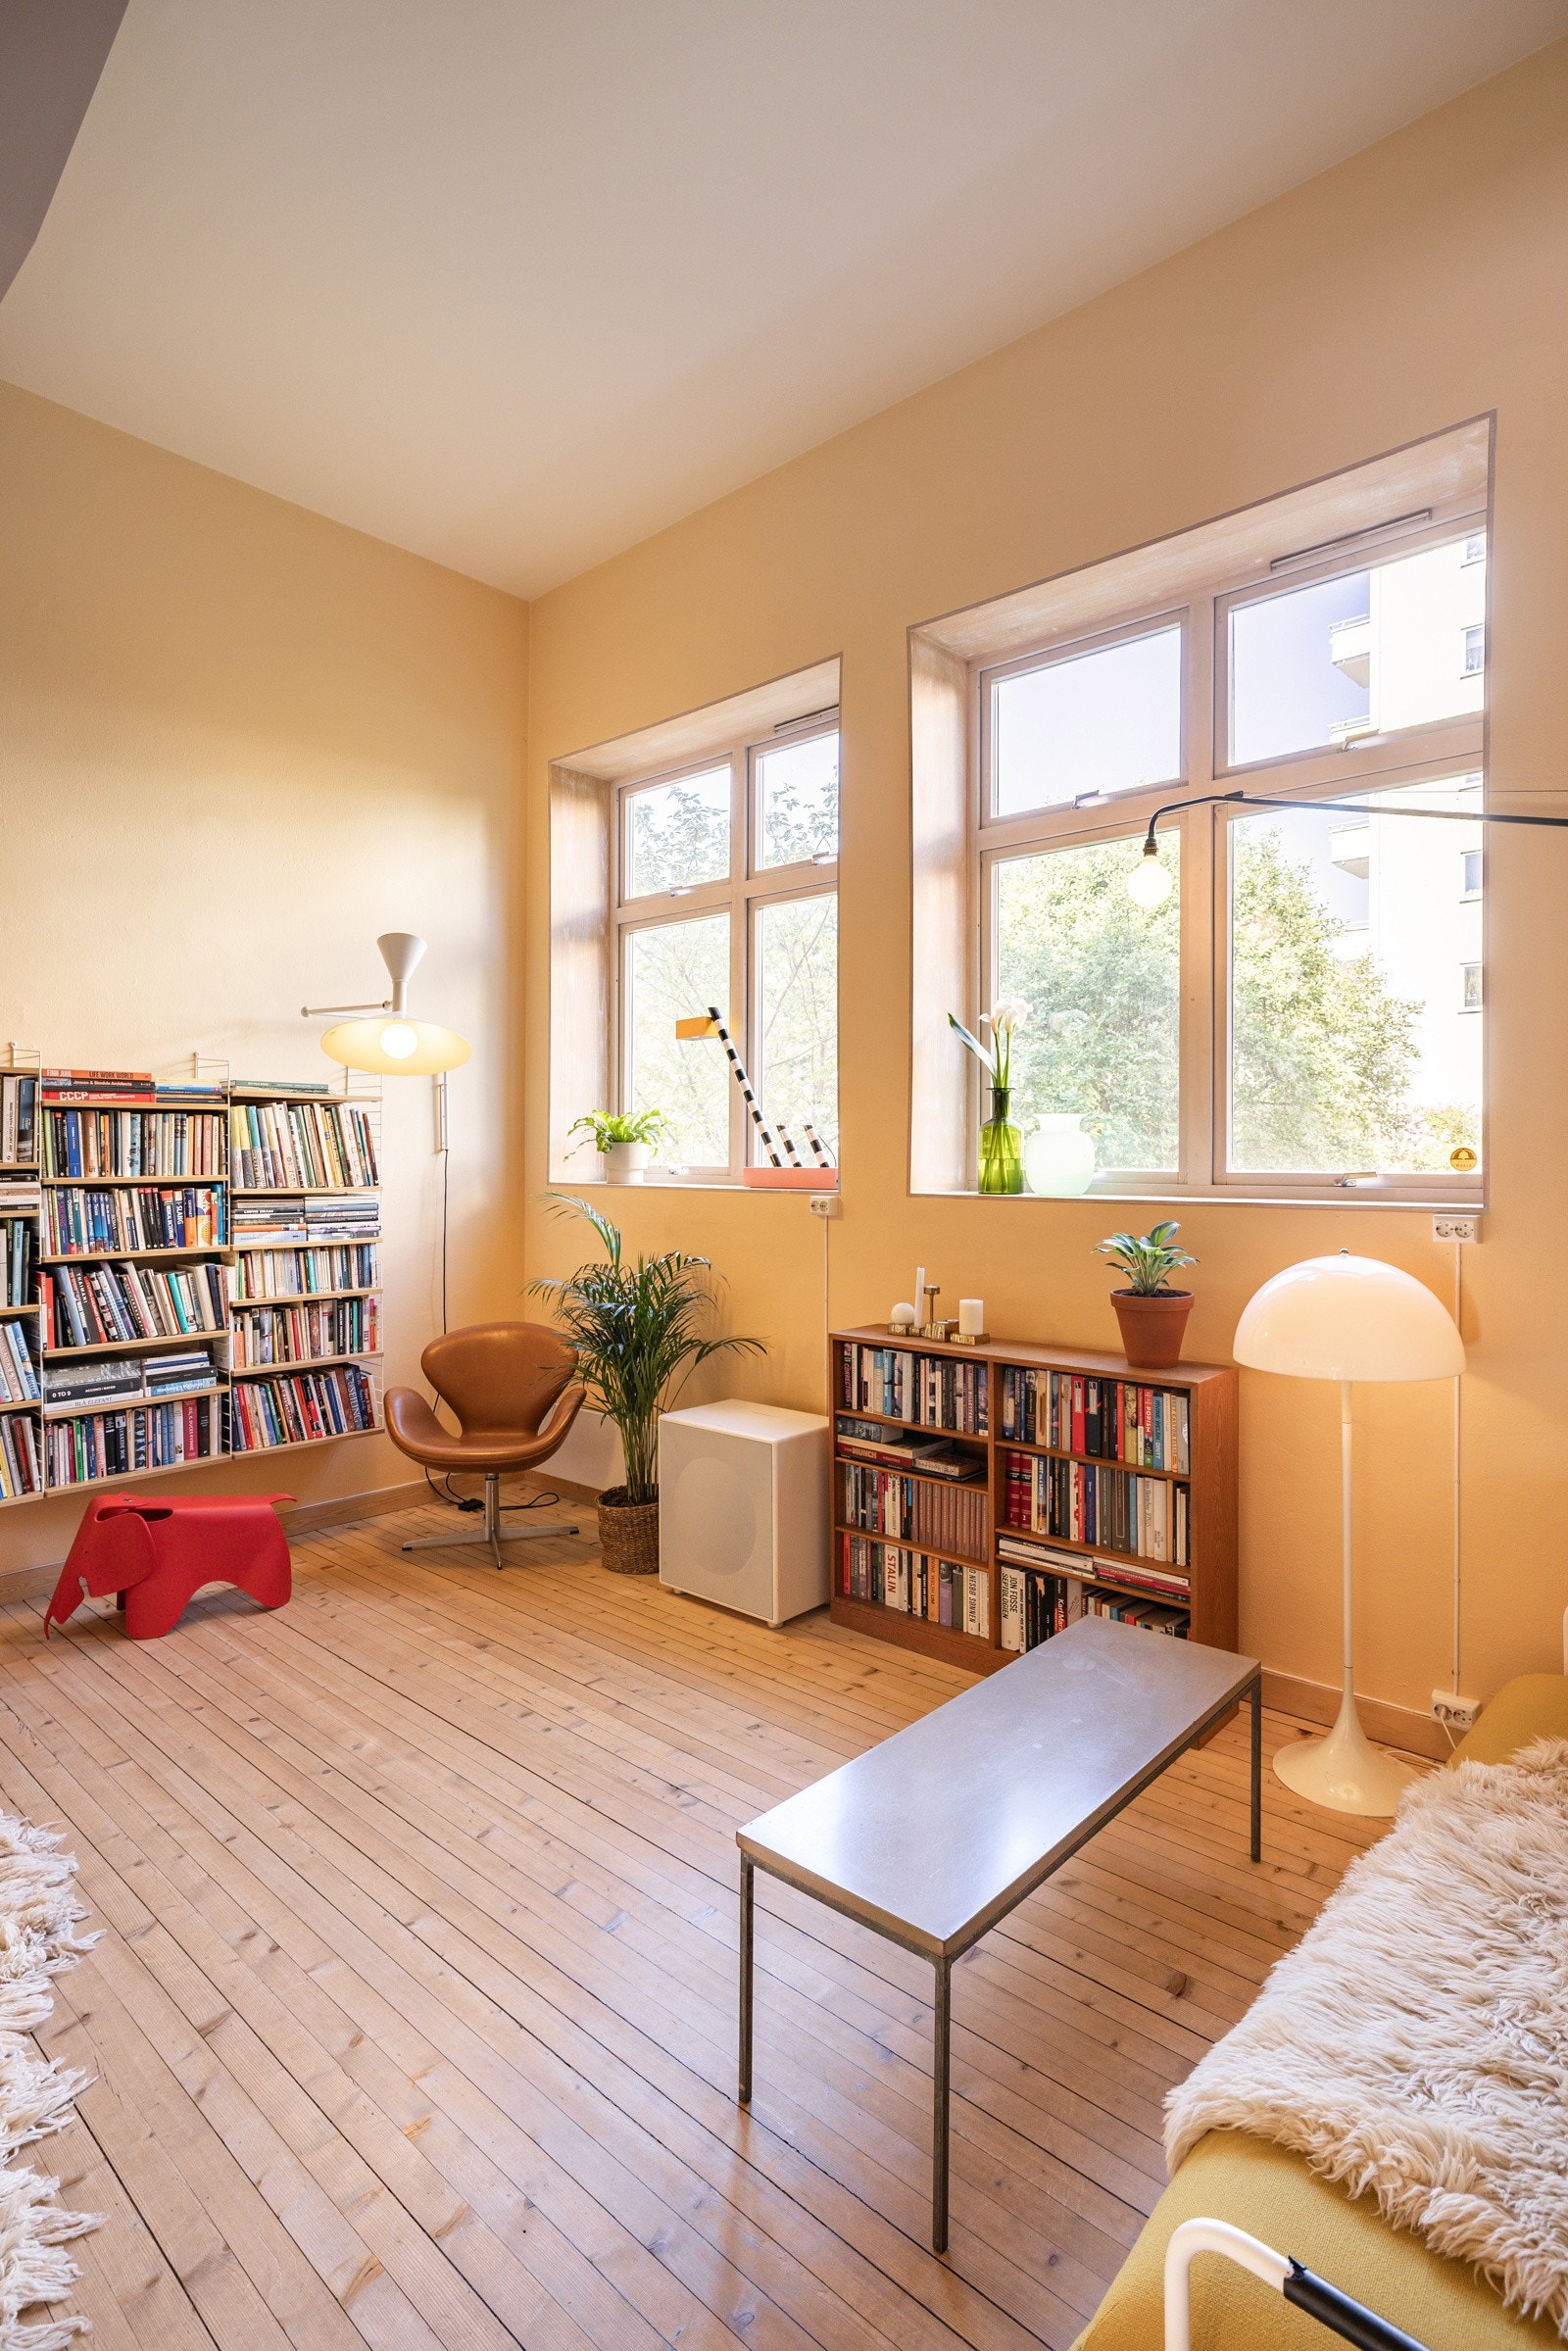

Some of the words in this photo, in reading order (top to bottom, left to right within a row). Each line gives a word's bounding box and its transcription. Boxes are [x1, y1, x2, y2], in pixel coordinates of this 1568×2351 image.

[60, 1092, 88, 1101] CCCP
[87, 1396, 112, 1405] ELEFANT
[348, 1387, 360, 1422] SEILING
[853, 1446, 877, 1458] MUNCH
